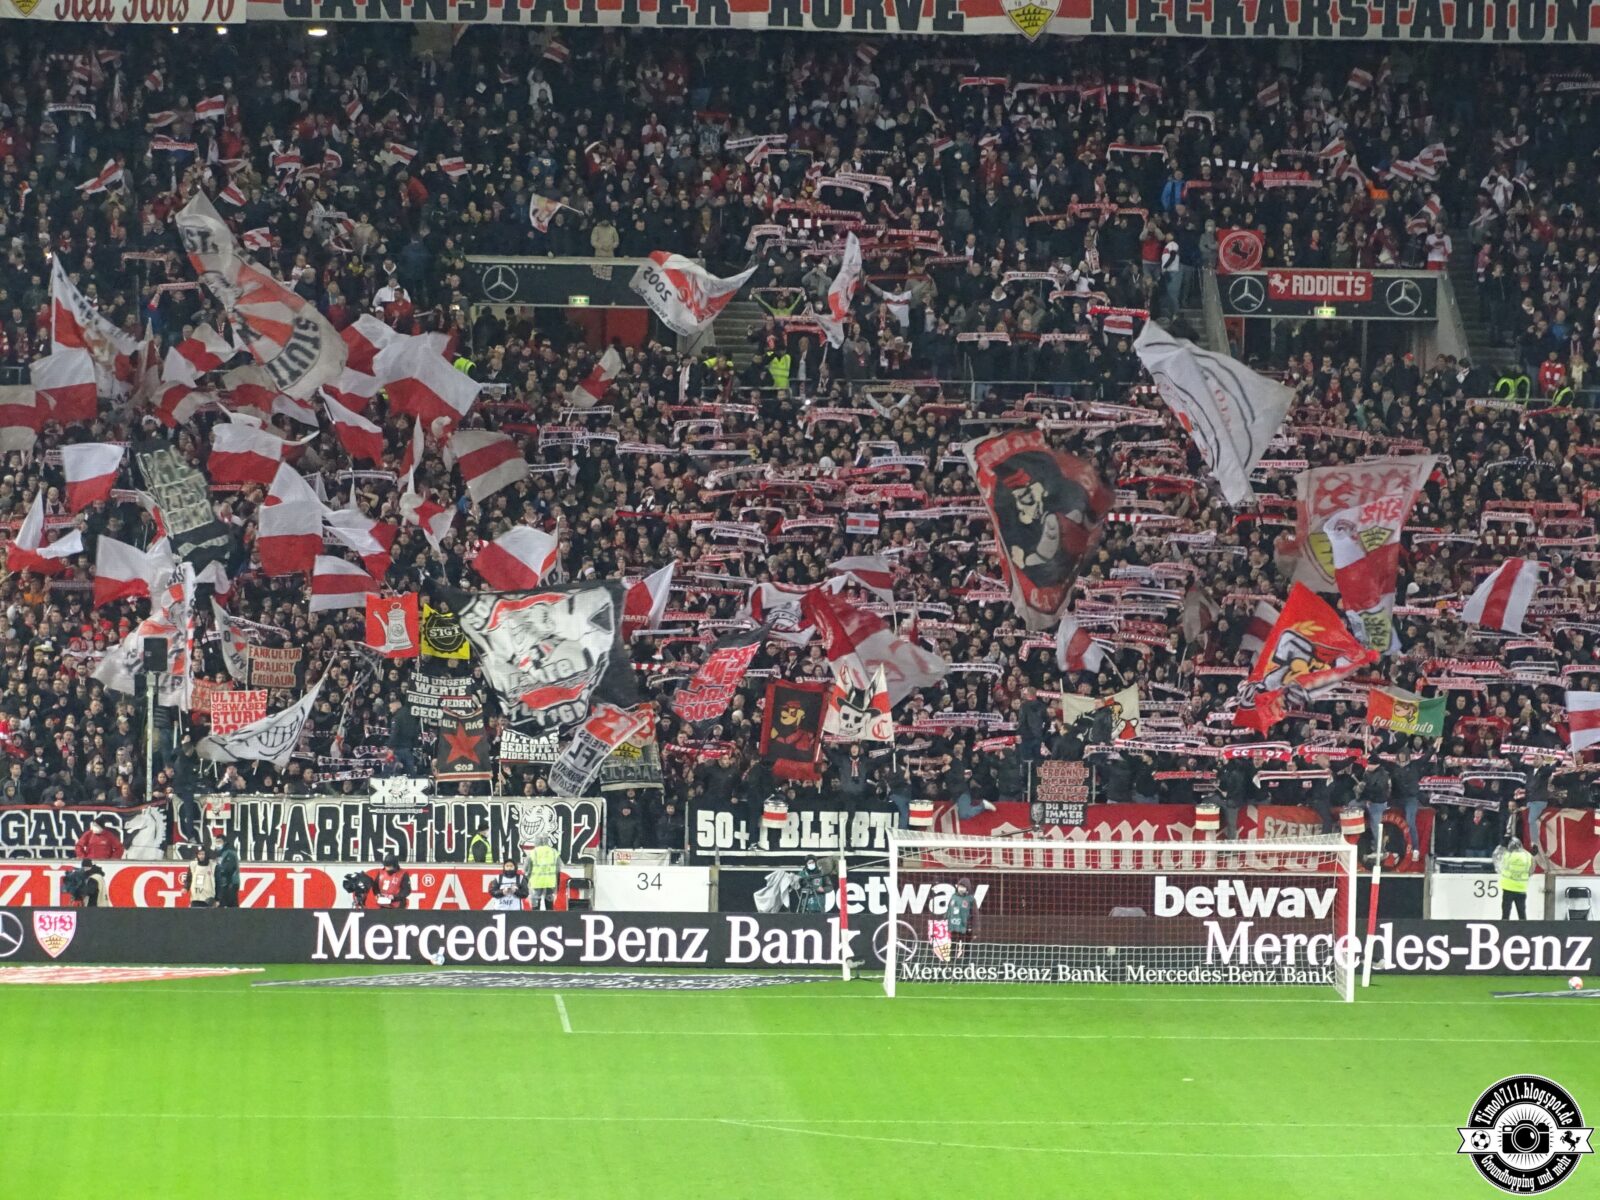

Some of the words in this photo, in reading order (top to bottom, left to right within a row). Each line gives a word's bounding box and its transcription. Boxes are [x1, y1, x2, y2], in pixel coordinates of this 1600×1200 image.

[1090, 0, 1591, 41] NECKARSTADION
[1291, 275, 1366, 297] ADDICTS
[429, 625, 460, 637] STGT
[254, 661, 294, 673] BRAUCHT
[411, 671, 429, 683] FÜR
[415, 682, 467, 696] WERTE
[211, 691, 267, 702] ULTRAS
[407, 694, 438, 706] GEGEN
[440, 699, 472, 708] JEDEN
[211, 702, 267, 712] SCHWABEN
[212, 712, 267, 725] STURM
[1371, 715, 1434, 734] Commando
[501, 730, 559, 745] ULTRAS
[500, 741, 559, 752] BEDEUTET
[1304, 745, 1347, 754] Commando
[500, 752, 560, 762] WIDERSTAND
[1232, 749, 1249, 758] CC
[1265, 750, 1284, 759] 97
[1062, 803, 1084, 811] BIST
[1045, 810, 1084, 819] IMMER
[1264, 816, 1323, 839] SZENE
[636, 872, 663, 891] 34
[1473, 879, 1499, 899] 35
[311, 911, 709, 963] Mercedes-Benz
[724, 915, 861, 965] Bank
[1203, 920, 1594, 972] Mercedes-Benz
[901, 963, 1051, 982] Mercedes-Benz
[1057, 963, 1110, 983] Bank
[1126, 964, 1277, 984] Mercedes-Benz
[1282, 966, 1335, 985] Bank
